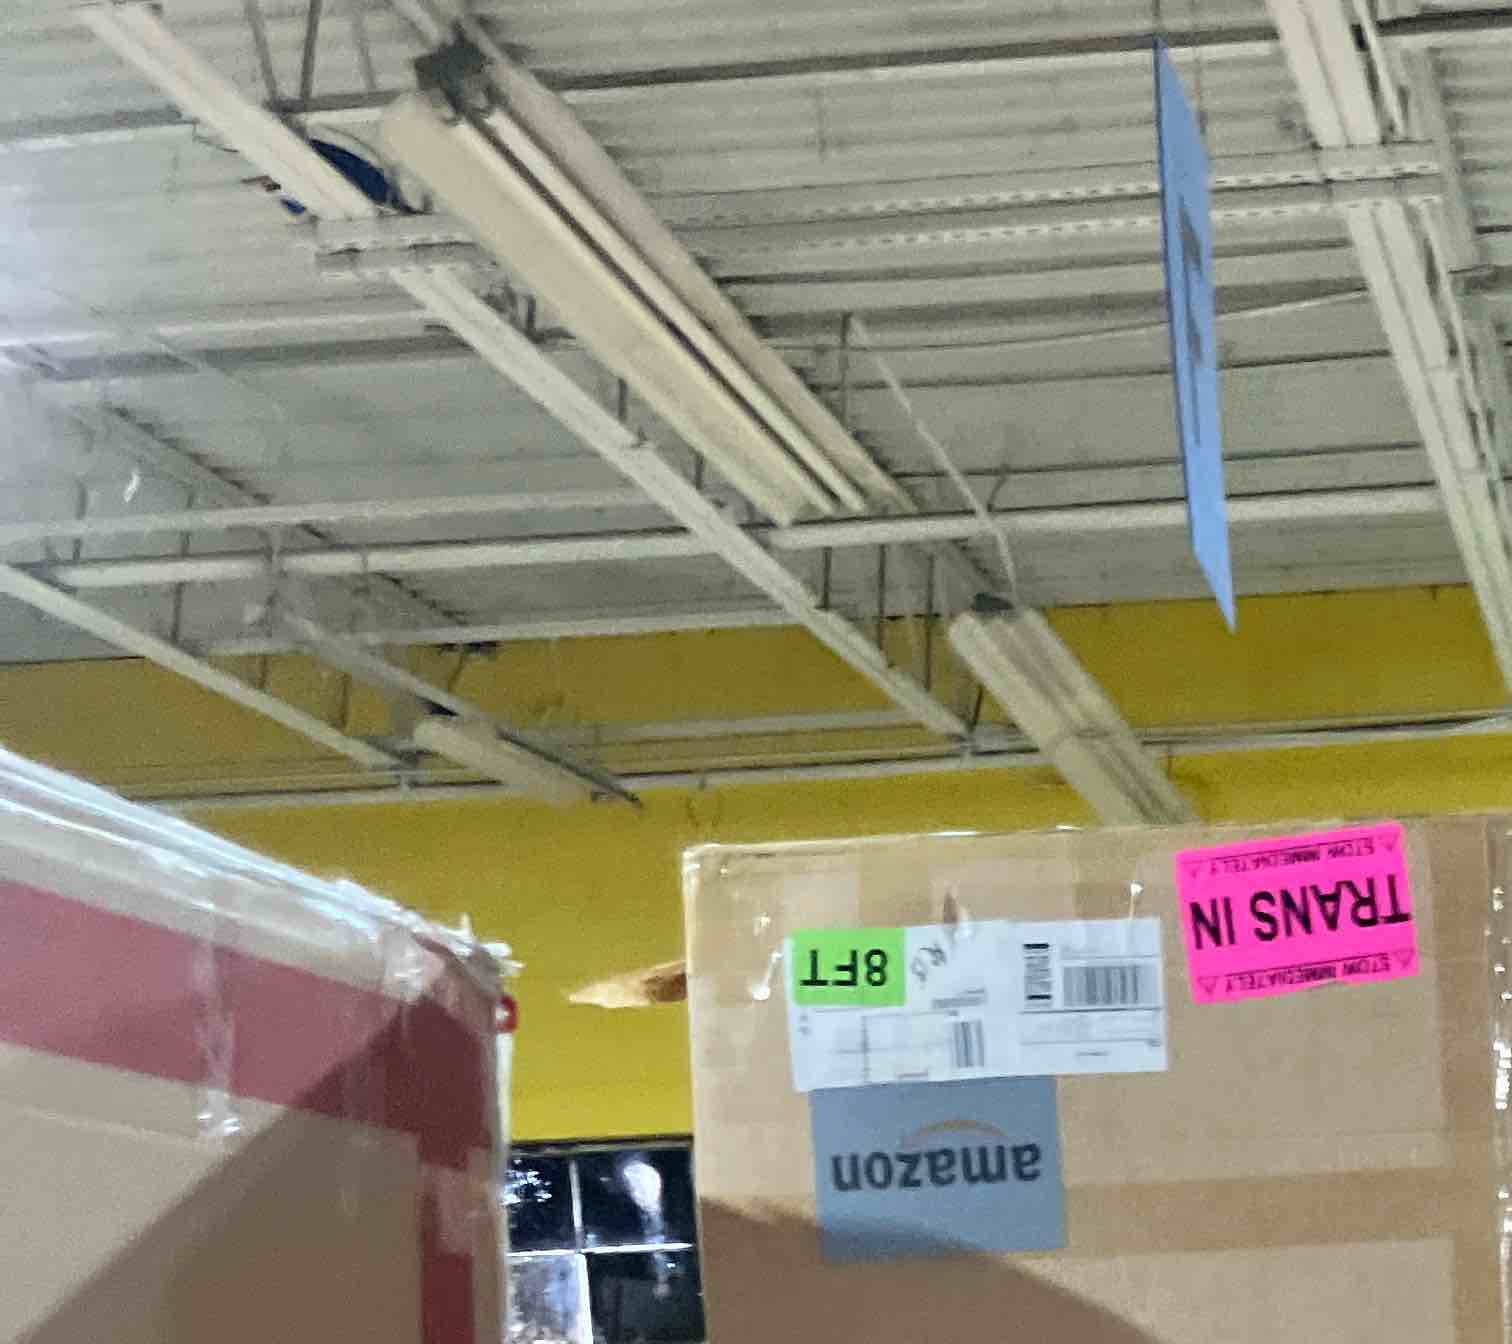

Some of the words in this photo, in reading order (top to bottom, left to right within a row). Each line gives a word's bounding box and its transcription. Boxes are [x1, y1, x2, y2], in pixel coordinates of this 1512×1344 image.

[1190, 897, 1235, 950] IN
[1249, 875, 1412, 942] TRANS
[800, 948, 888, 986] 8FT
[831, 1141, 1043, 1193] amazon
